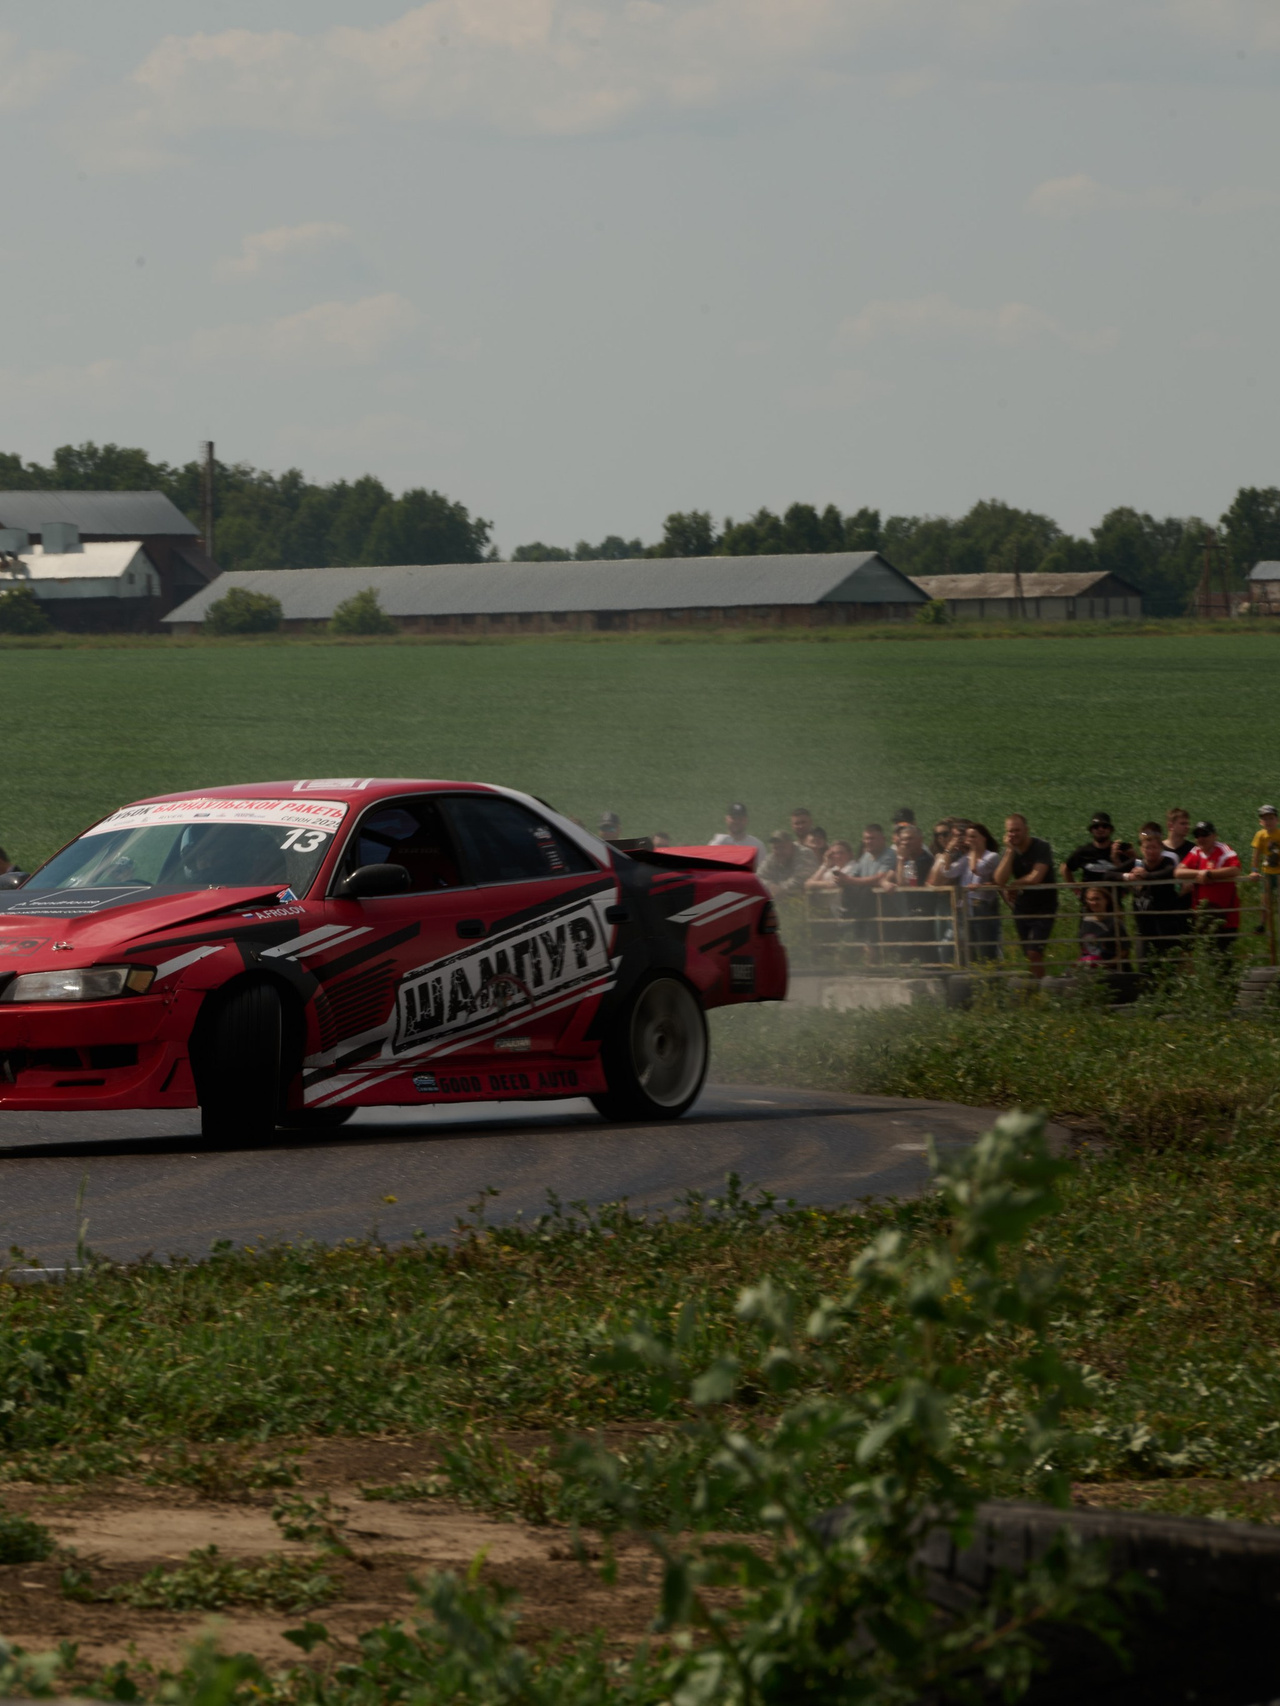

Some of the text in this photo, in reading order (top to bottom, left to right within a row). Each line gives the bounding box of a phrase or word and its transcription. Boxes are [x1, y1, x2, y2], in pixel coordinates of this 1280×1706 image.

[280, 828, 327, 853] 13
[254, 905, 306, 920] A.FROLOV
[404, 917, 595, 1038] ШАМПУР
[439, 1069, 579, 1094] GOOD DEED AUTO
